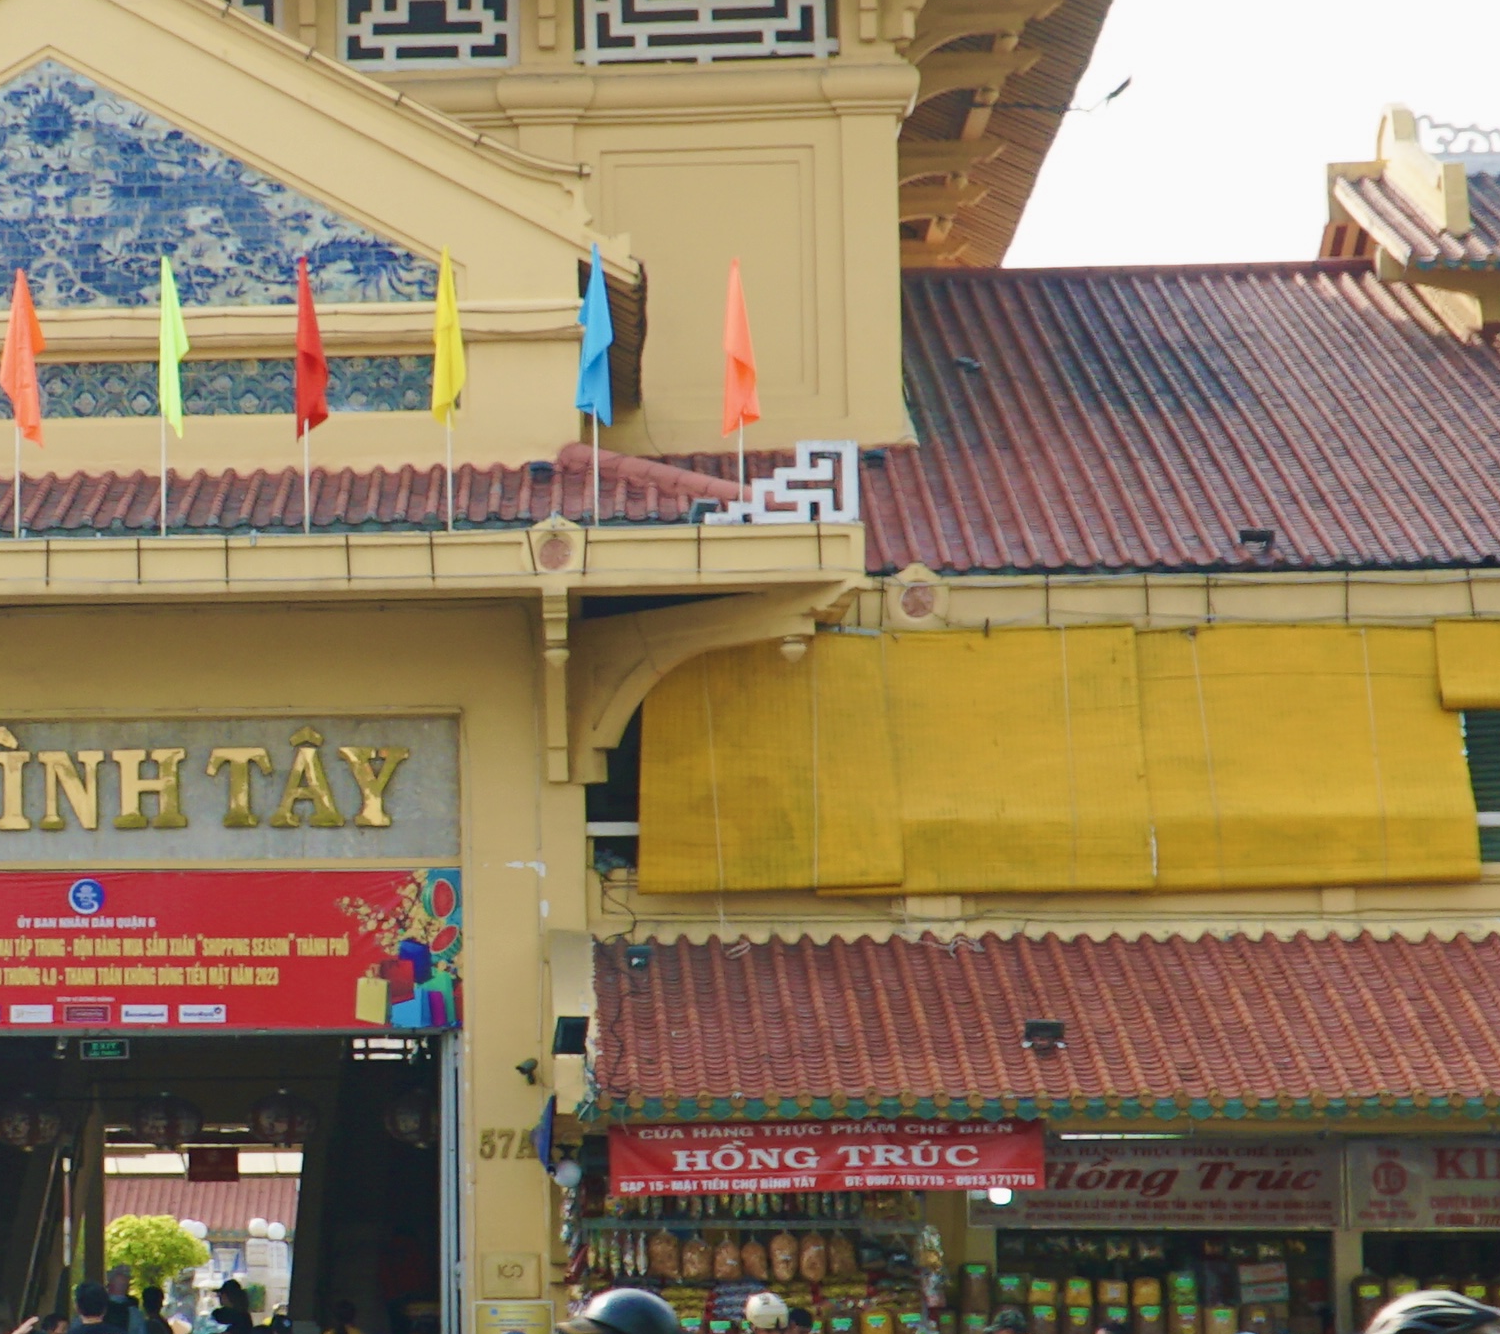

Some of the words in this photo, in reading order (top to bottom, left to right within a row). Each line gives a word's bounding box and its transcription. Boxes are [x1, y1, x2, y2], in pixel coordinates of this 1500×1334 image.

[208, 725, 410, 829] TÂY
[33, 917, 58, 929] BAN
[59, 915, 90, 929] NHÂN
[91, 915, 115, 929] DÂN
[116, 914, 147, 930] QUẬN
[91, 1042, 117, 1051] EXIT
[480, 1129, 539, 1159] 57A
[638, 1126, 687, 1141] CỬA
[692, 1124, 754, 1139] HÀNG
[760, 1123, 823, 1138] THỰC
[831, 1119, 897, 1136] PHẨM
[904, 1120, 951, 1135] CHẾ
[671, 1139, 820, 1173] HỒNG
[837, 1140, 981, 1168] TRÚC
[1045, 1158, 1179, 1198] Hồng
[1197, 1160, 1322, 1192] Trúc
